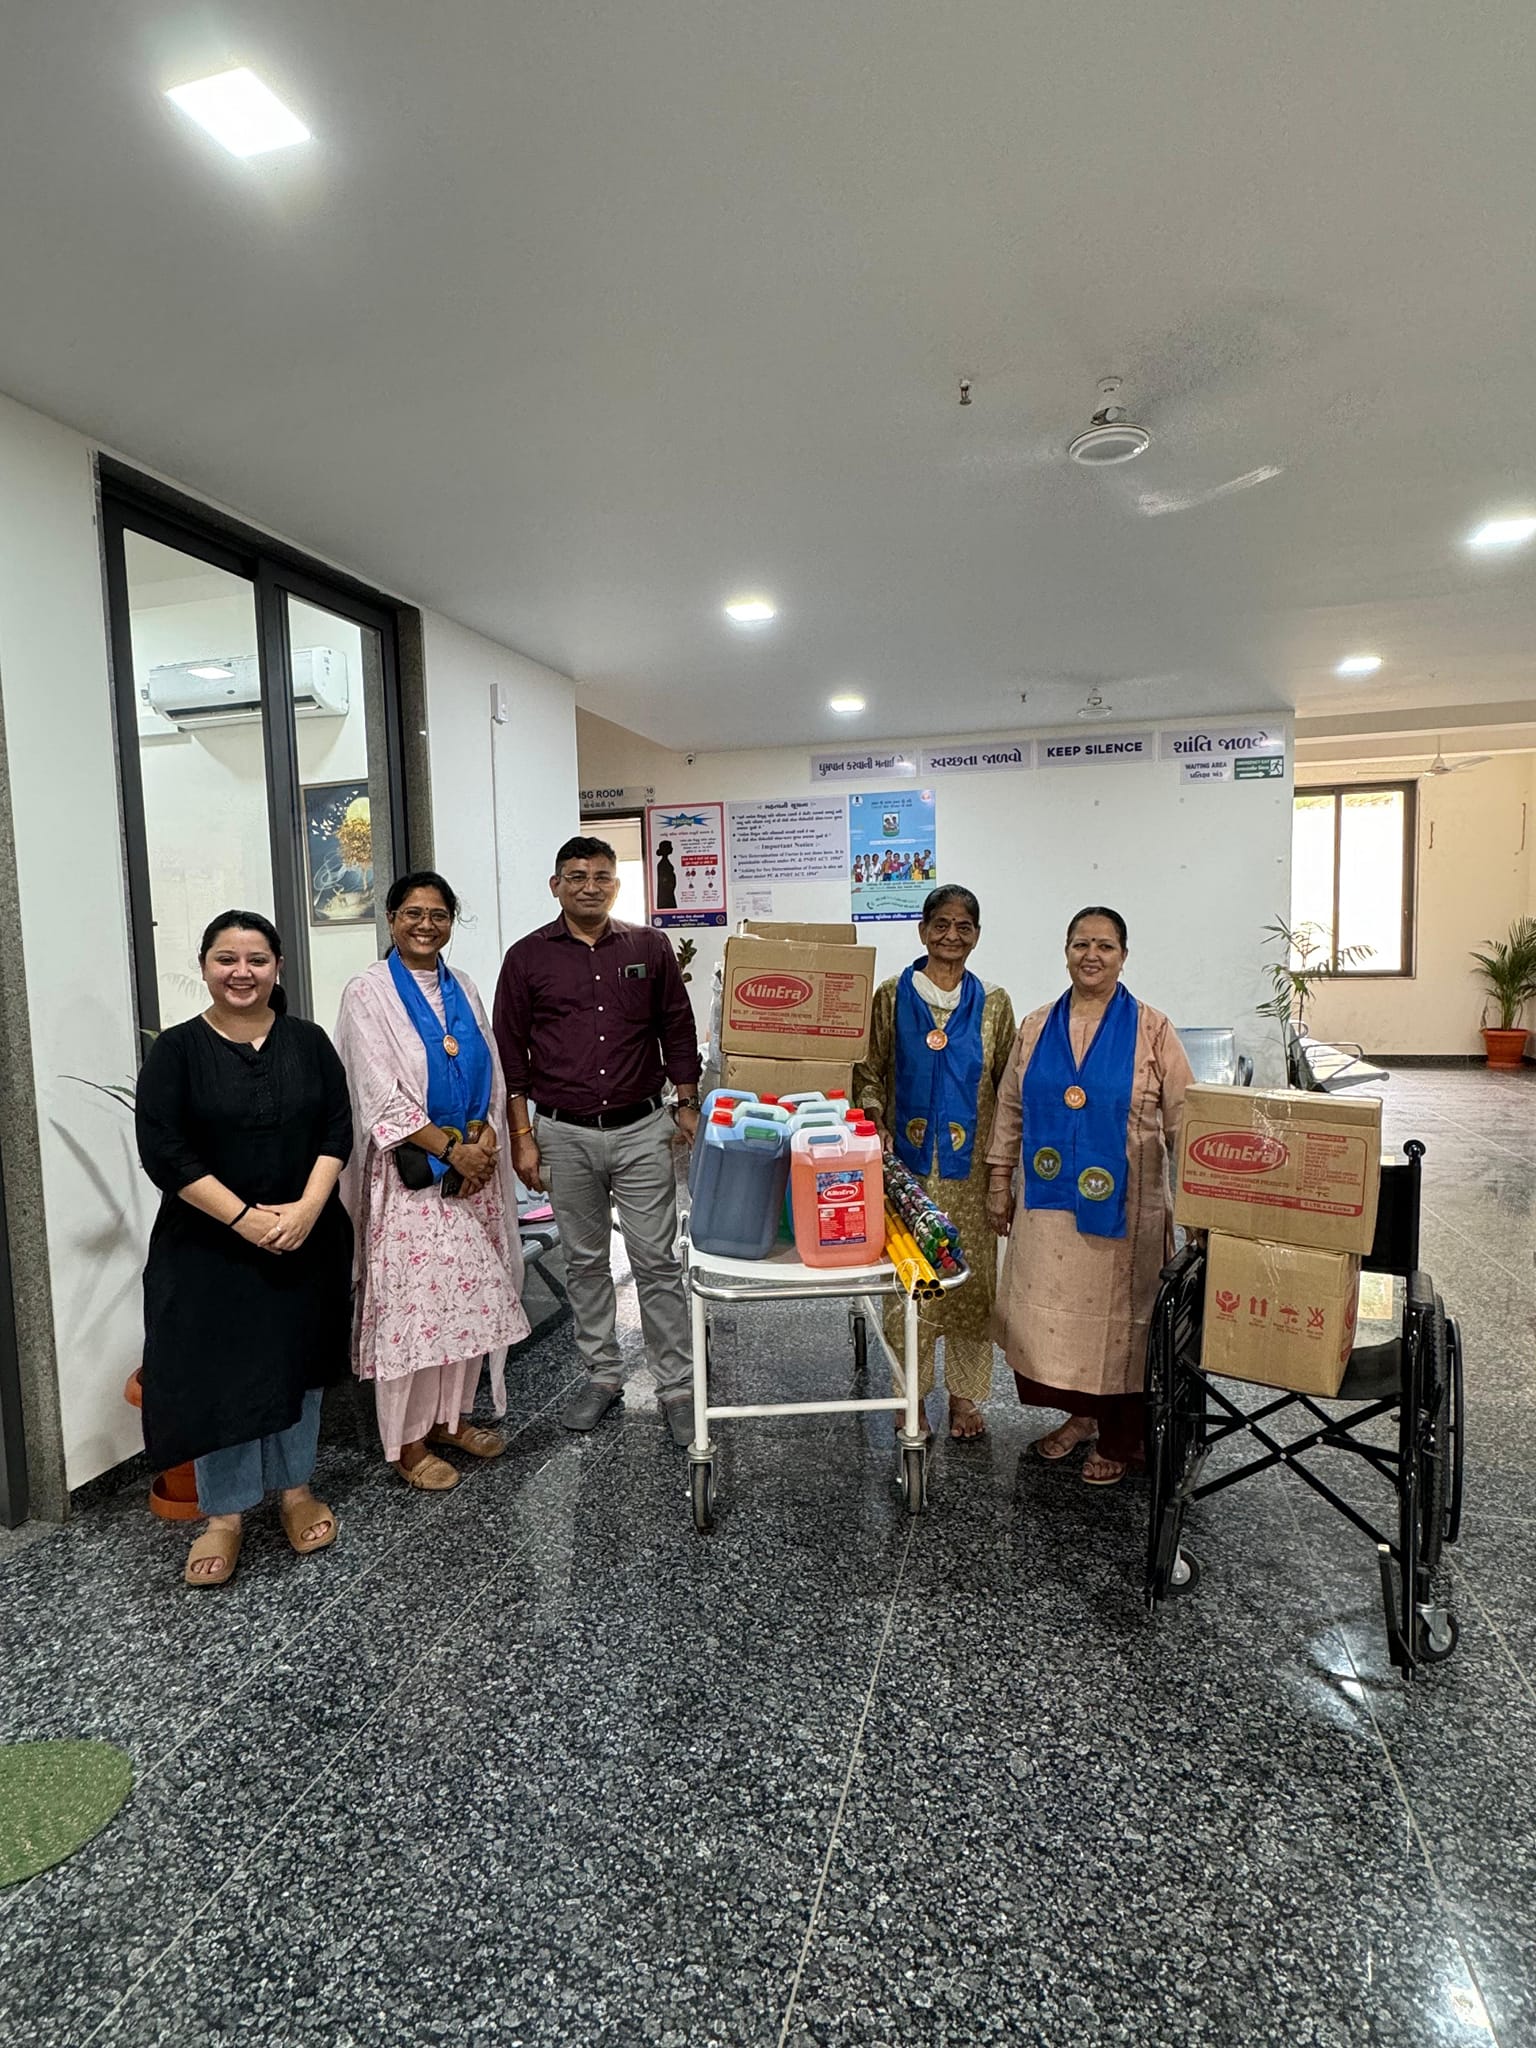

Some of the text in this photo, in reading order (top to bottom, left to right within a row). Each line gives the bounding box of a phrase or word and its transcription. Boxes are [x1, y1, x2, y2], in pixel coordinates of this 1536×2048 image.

[1047, 741, 1143, 757] KEEP SILENCE
[1172, 734, 1212, 753] શાંતિ
[982, 748, 1022, 764] જાળવો
[1185, 762, 1210, 770] WAITING
[596, 788, 624, 799] ROOM
[745, 983, 802, 1000] KlinEra
[1202, 1140, 1278, 1164] KlinEra
